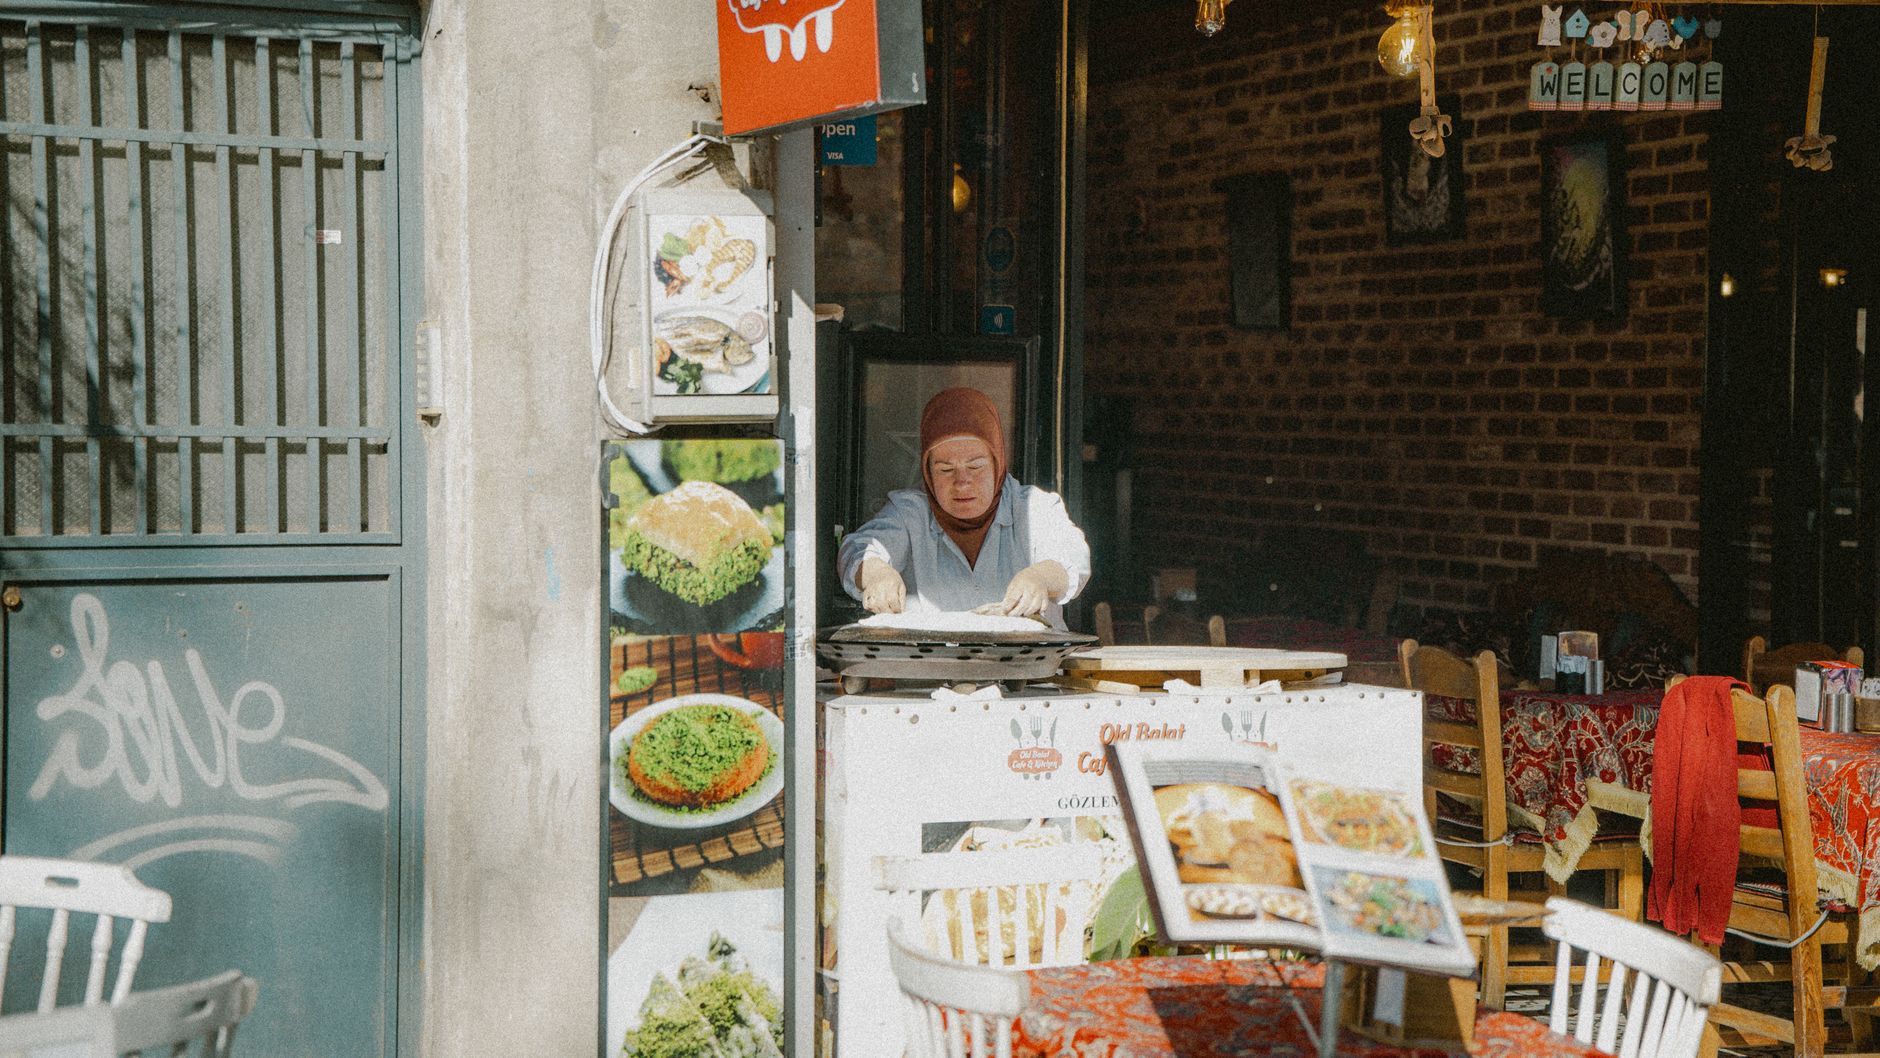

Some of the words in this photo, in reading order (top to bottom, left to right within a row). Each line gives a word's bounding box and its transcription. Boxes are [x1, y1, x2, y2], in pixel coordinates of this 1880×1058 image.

[1541, 71, 1720, 96] WELCOME
[827, 152, 843, 160] VISA
[1099, 722, 1132, 746] Old
[1136, 722, 1186, 741] Balat
[1077, 751, 1108, 777] Caf
